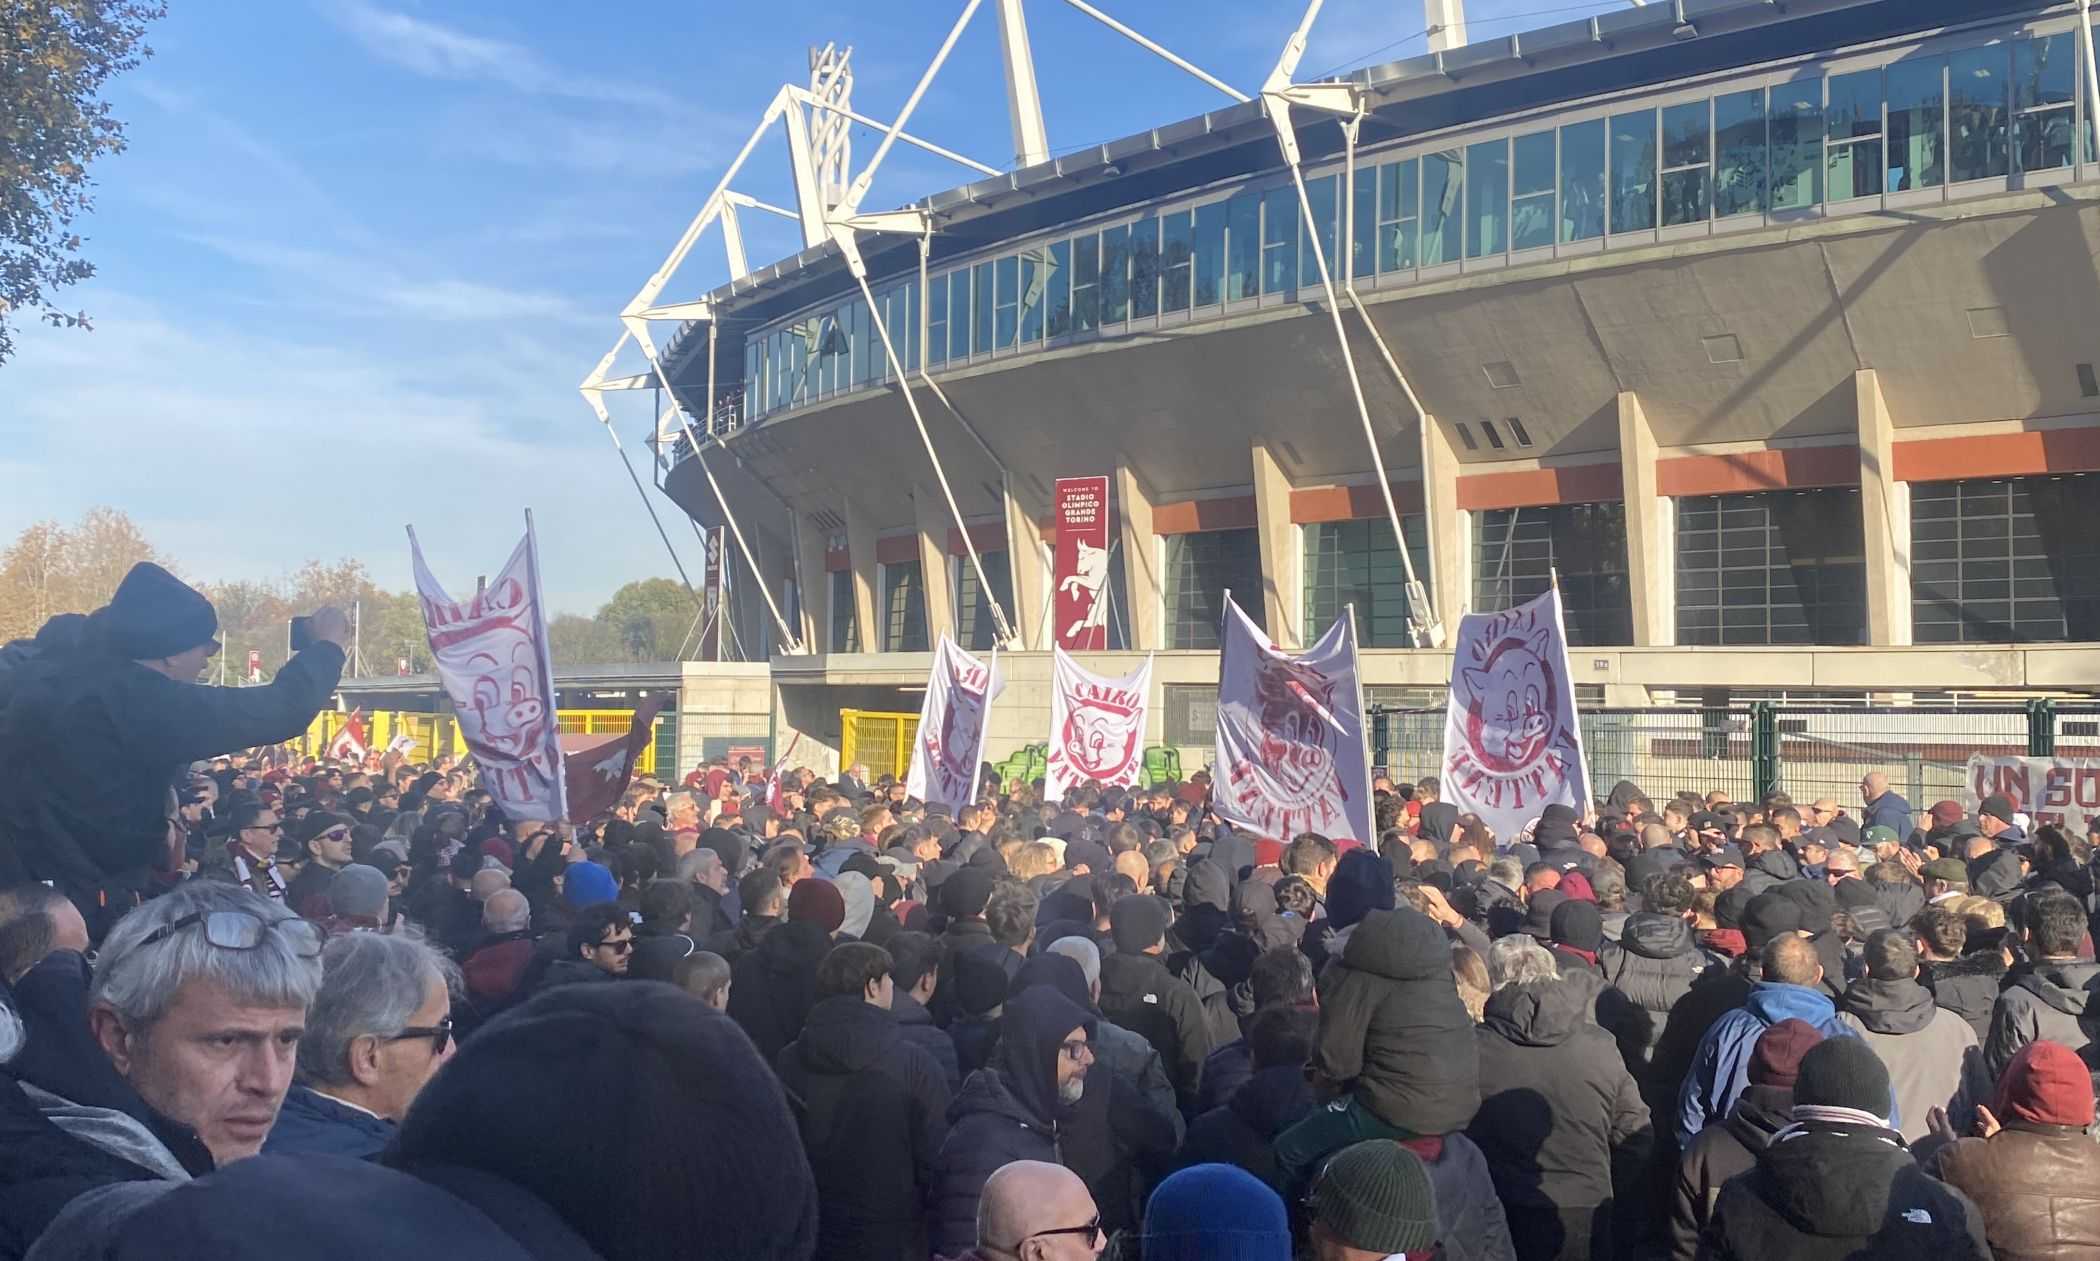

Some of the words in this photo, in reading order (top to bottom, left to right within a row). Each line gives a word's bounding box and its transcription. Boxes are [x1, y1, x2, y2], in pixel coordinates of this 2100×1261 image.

[1061, 501, 1100, 509] OLIMPICO
[1065, 516, 1095, 524] TORINO
[1075, 683, 1141, 709] CAIRO
[1975, 765, 2031, 805] UN
